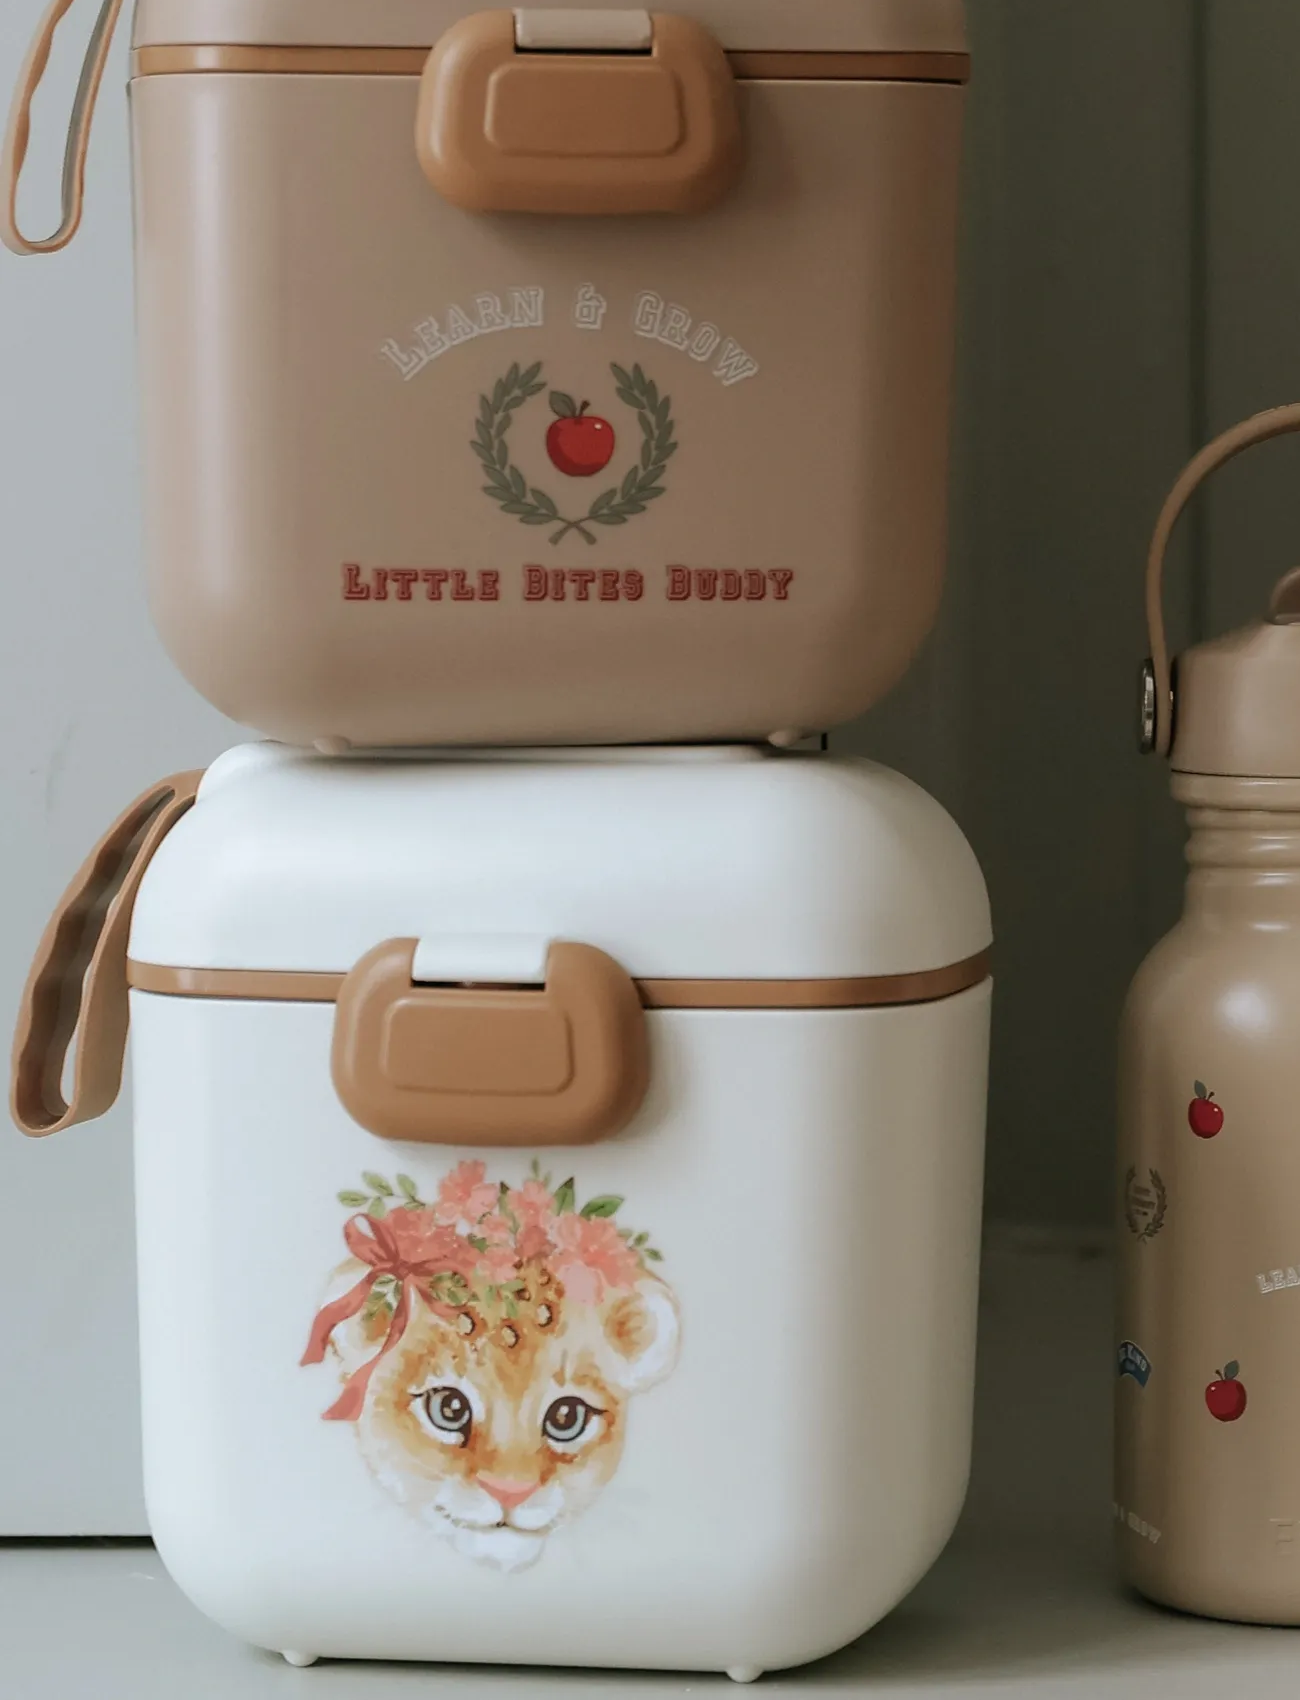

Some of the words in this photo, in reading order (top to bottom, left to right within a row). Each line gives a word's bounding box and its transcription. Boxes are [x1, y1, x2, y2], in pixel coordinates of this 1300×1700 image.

[379, 287, 545, 382] LEARN
[573, 283, 606, 331] &
[634, 290, 759, 387] GROW
[342, 563, 500, 601] LITTLE
[523, 564, 644, 601] BITES
[665, 565, 795, 601] BUDDY
